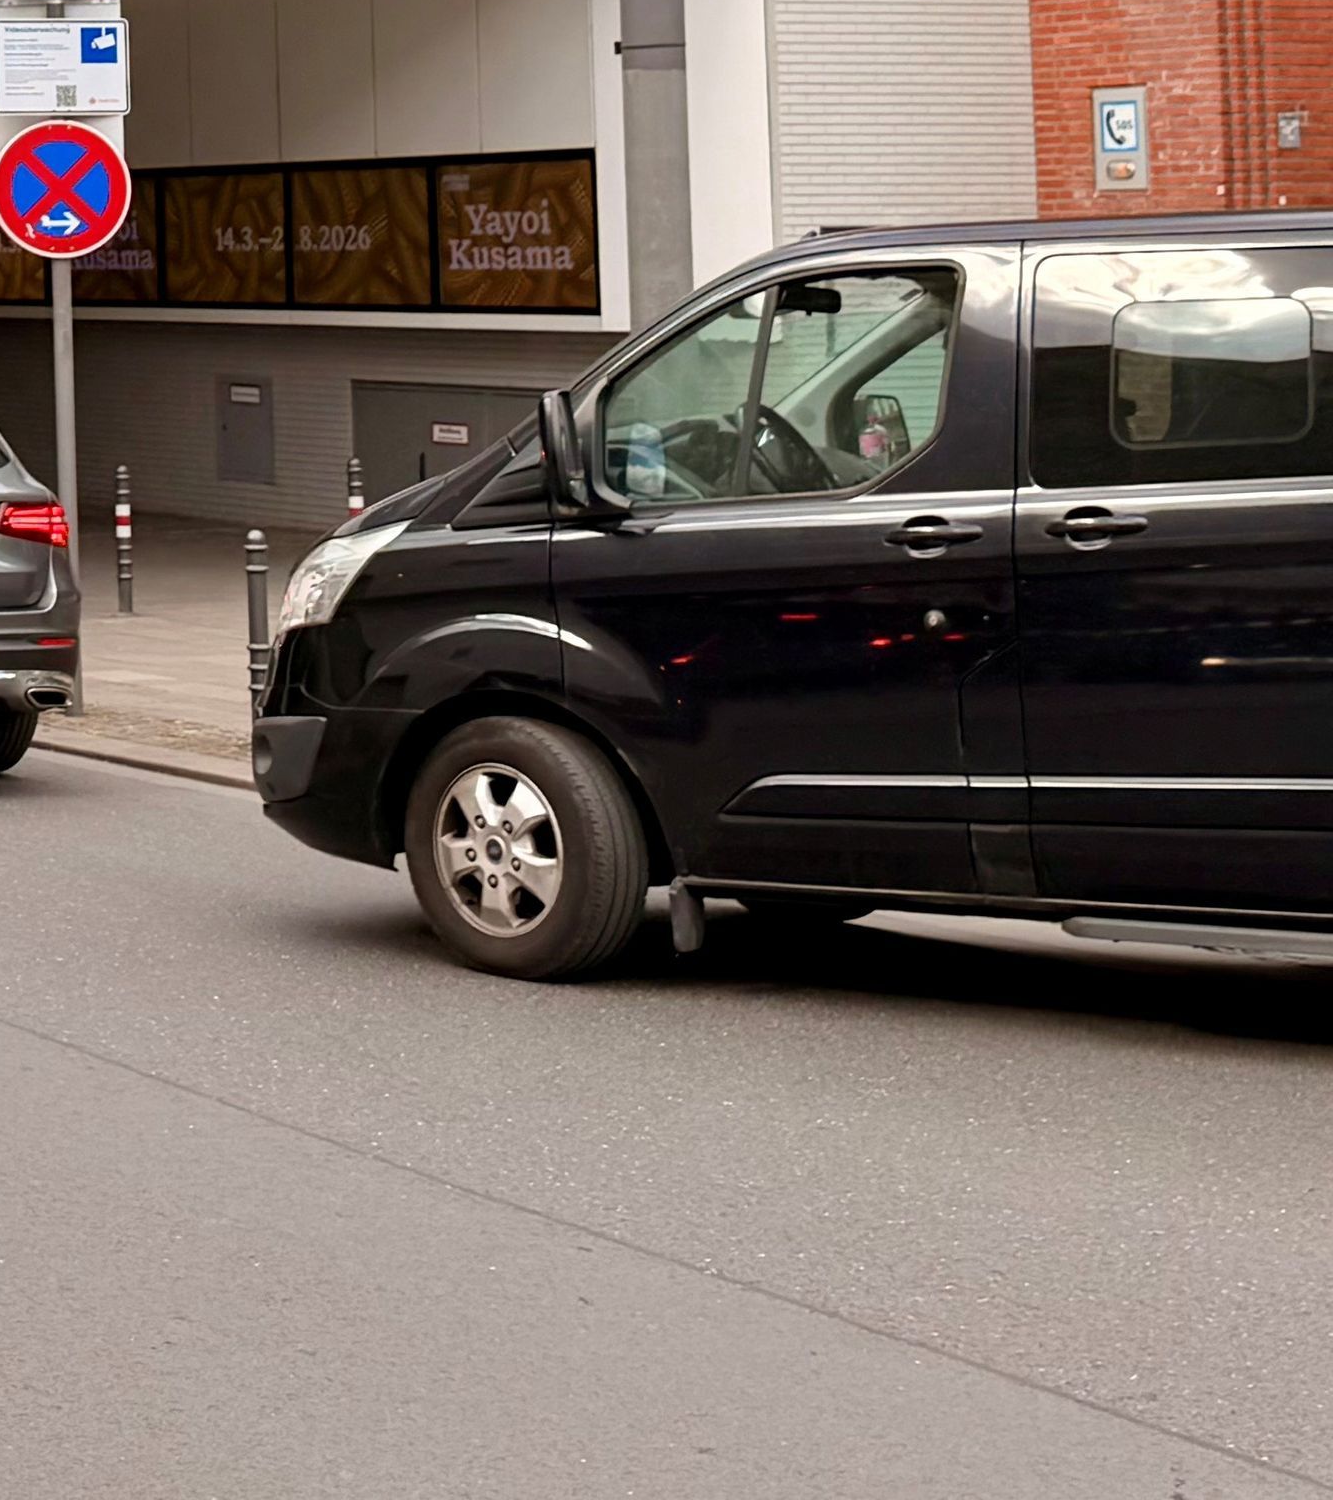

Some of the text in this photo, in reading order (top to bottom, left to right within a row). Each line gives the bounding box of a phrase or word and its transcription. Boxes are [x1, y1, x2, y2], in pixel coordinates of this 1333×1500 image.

[464, 199, 551, 243] Yayoi
[74, 250, 154, 270] usama
[448, 239, 575, 270] Kusama
